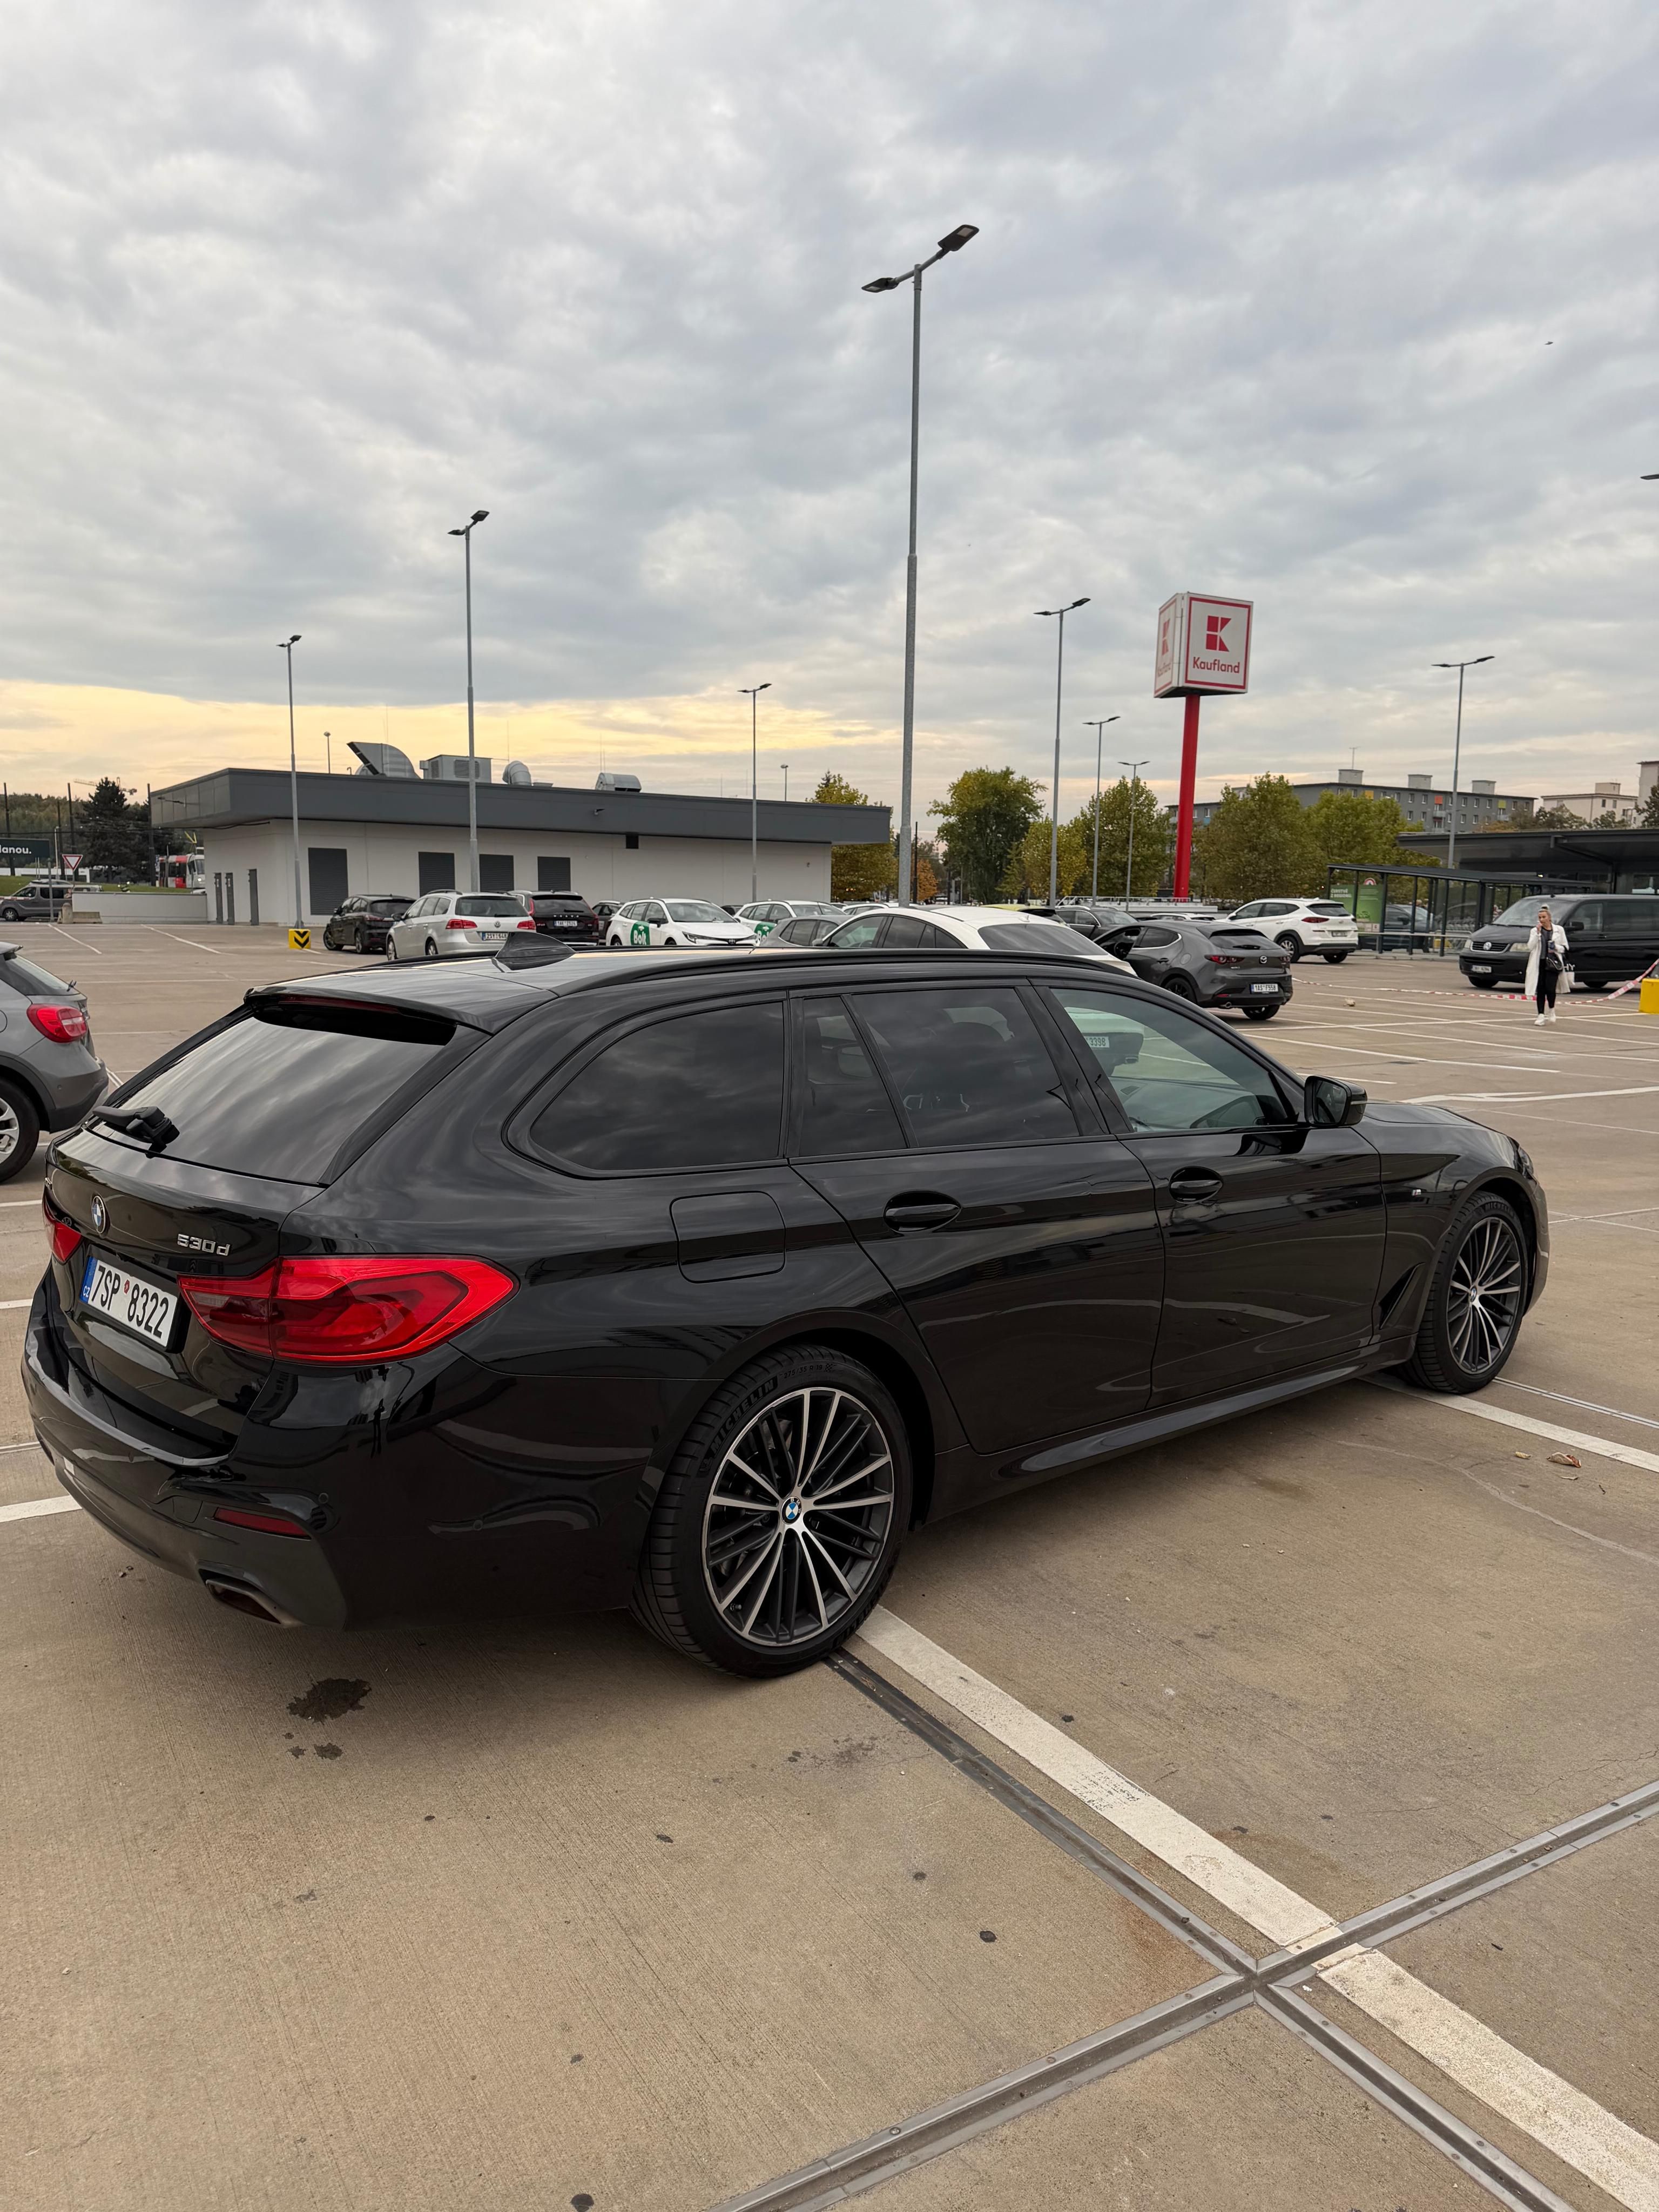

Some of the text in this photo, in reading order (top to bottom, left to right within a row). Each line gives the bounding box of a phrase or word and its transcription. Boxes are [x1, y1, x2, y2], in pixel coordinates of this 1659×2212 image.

[1192, 657, 1240, 674] Kaufland
[633, 929, 646, 945] Bolt
[1089, 1037, 1106, 1046] 3398
[177, 1233, 231, 1256] 530d
[83, 1286, 90, 1298] CZ
[91, 1265, 169, 1339] 7SP 8322
[784, 1366, 807, 1379] 275/35
[710, 1378, 776, 1454] MICHELIN
